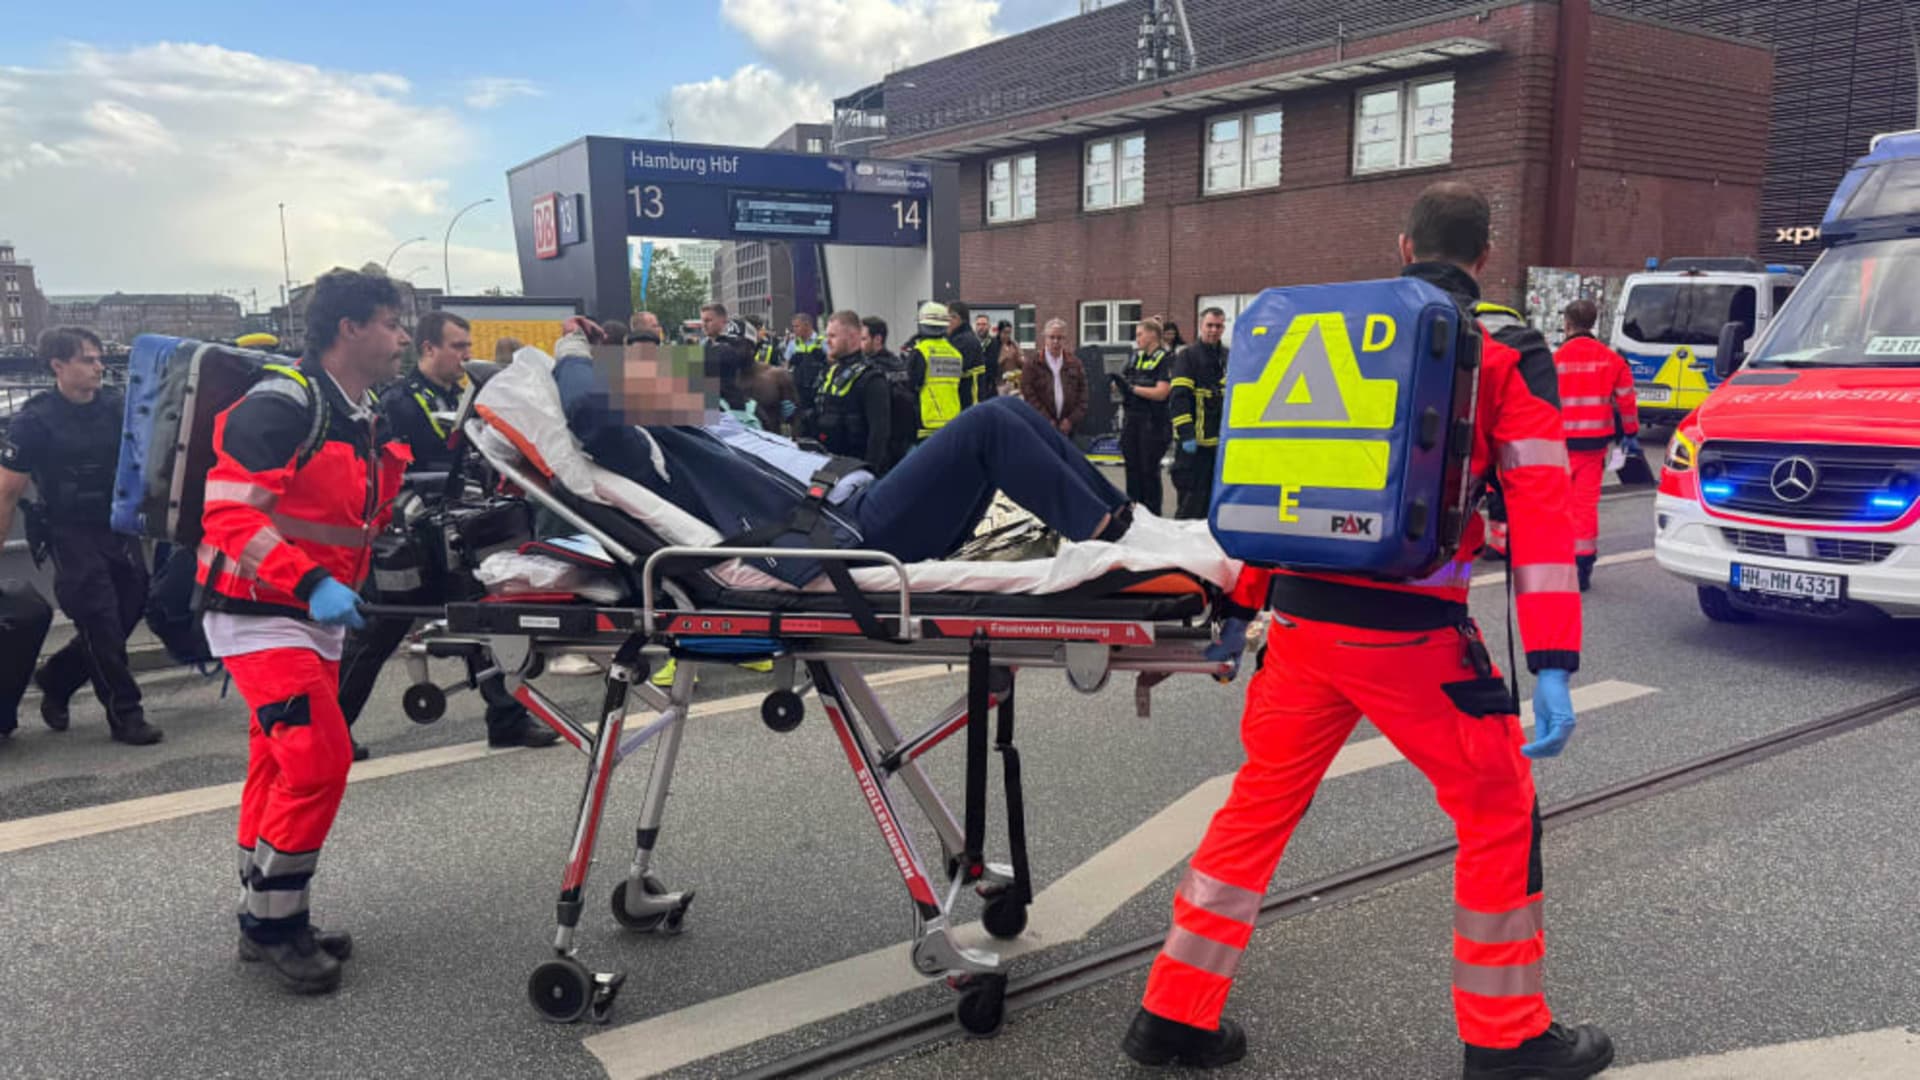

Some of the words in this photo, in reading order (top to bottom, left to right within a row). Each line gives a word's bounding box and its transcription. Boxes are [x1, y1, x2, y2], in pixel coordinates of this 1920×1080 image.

[631, 150, 706, 175] Hamburg
[711, 155, 739, 173] Hbf
[628, 185, 664, 218] 13
[892, 200, 921, 230] 14
[534, 200, 556, 252] DB
[1362, 313, 1397, 352] D
[1730, 388, 1920, 404] RETTUNGSDIE
[1278, 485, 1301, 523] E
[1331, 513, 1373, 536] PAX
[1741, 567, 1760, 586] HH
[1769, 573, 1792, 590] MH
[1794, 575, 1837, 596] 4331
[1055, 625, 1110, 637] Hamburg
